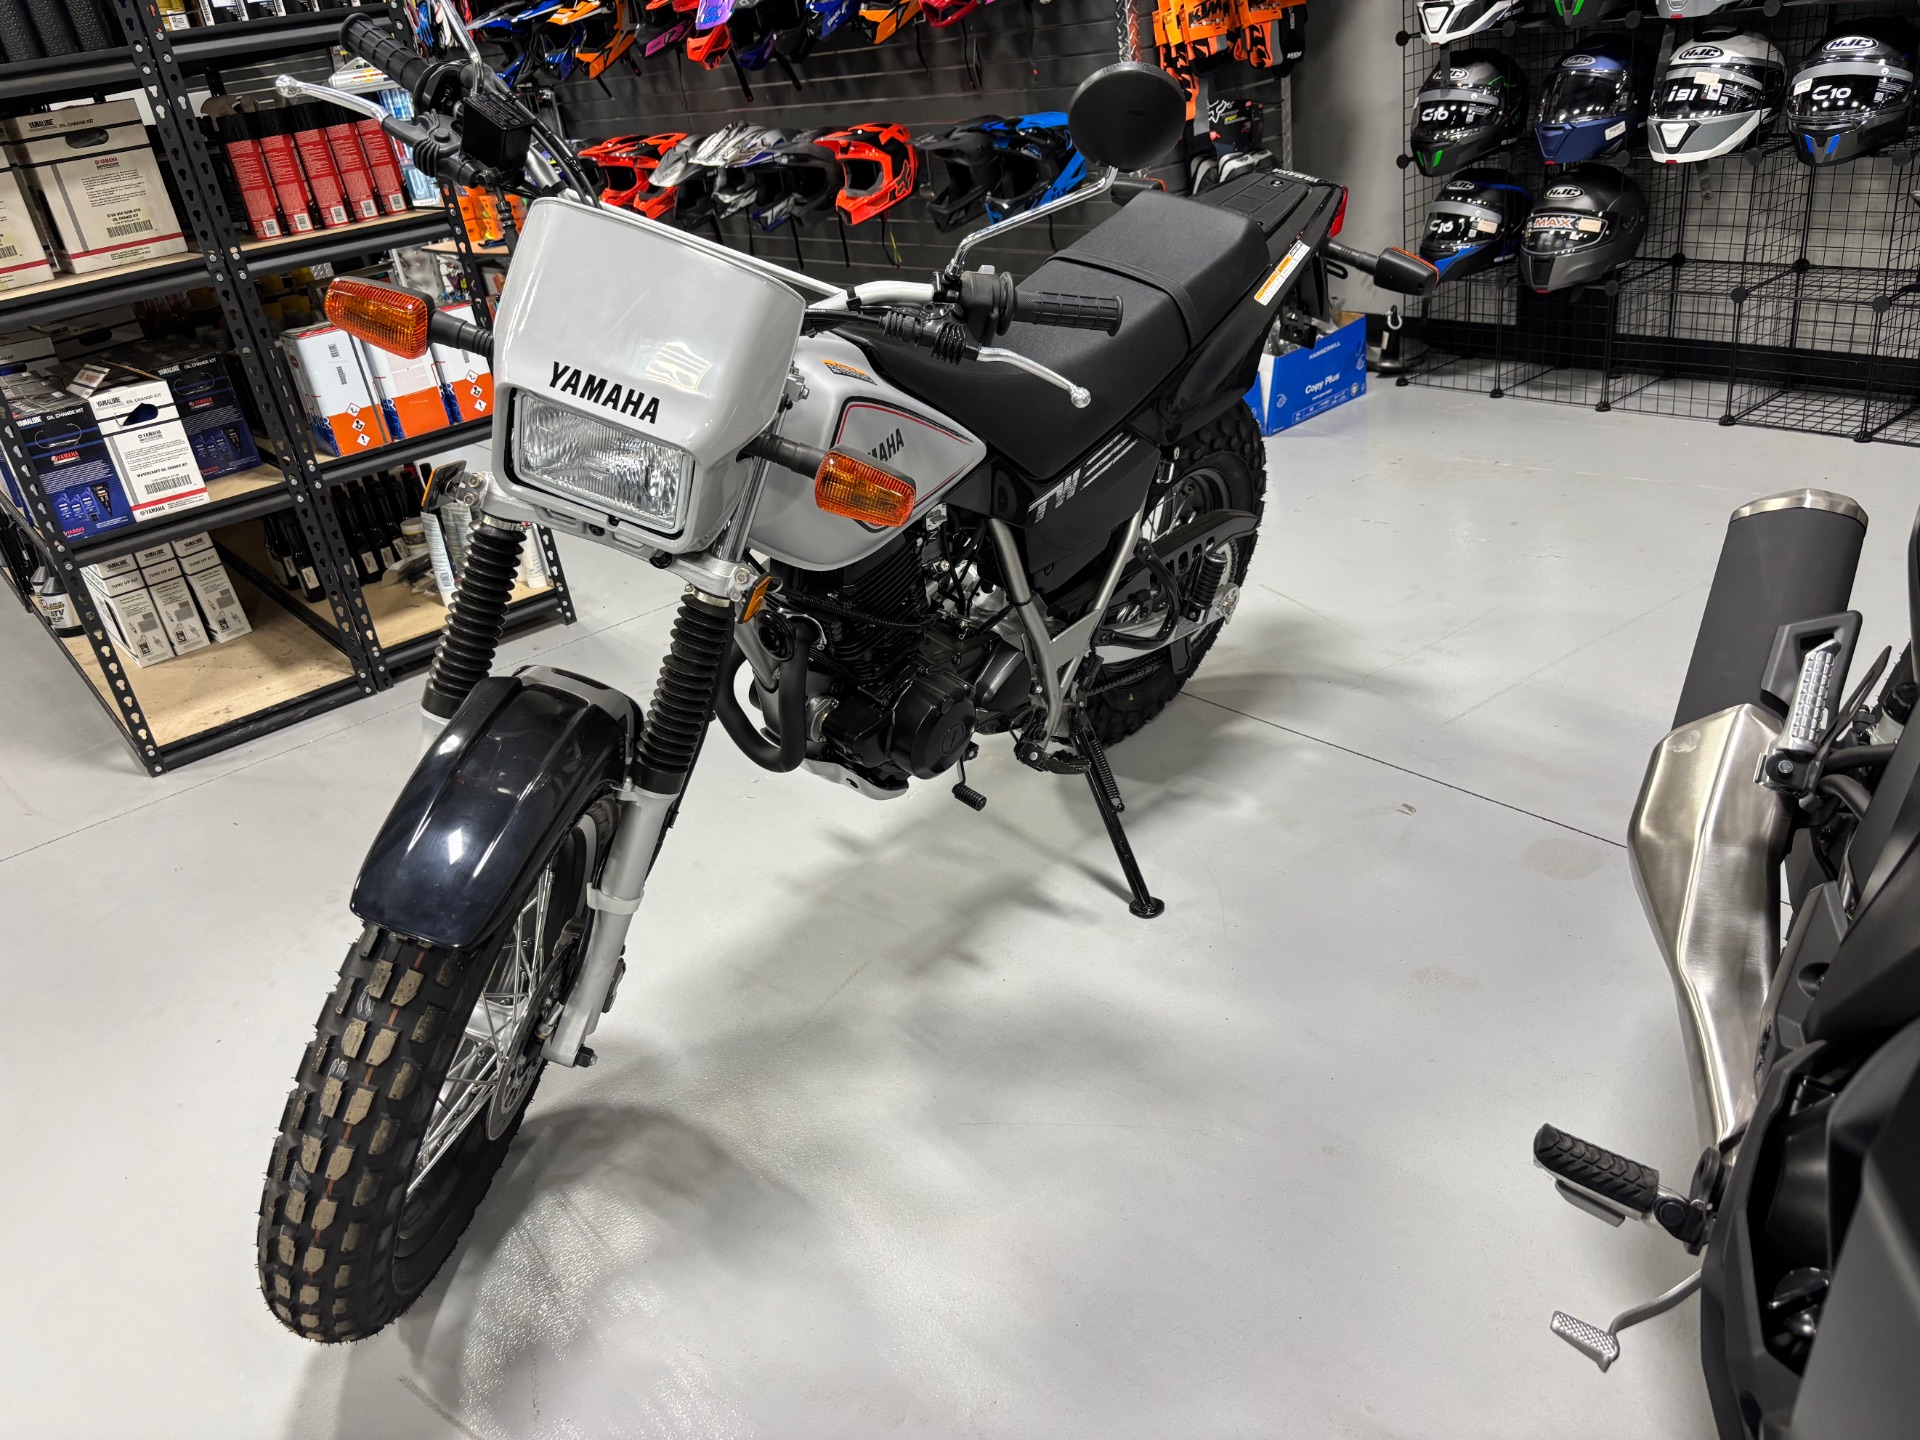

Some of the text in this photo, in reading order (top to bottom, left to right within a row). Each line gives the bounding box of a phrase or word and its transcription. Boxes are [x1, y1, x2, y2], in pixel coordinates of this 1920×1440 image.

[1829, 39, 1870, 49] HJC
[1684, 49, 1718, 57] HJC
[1812, 85, 1852, 100] C10
[28, 119, 54, 129] YAMALUBE
[1533, 216, 1576, 229] MAX
[1309, 341, 1341, 360] HAMMERMILL
[1305, 381, 1324, 395] Copy
[1325, 373, 1340, 386] Plus
[549, 361, 660, 424] YAMAHA
[96, 397, 121, 407] YAMALUBE
[16, 416, 42, 427] YAMALUBE
[55, 410, 75, 418] CHANGE
[57, 451, 79, 460] YAMAHA
[145, 505, 166, 515] YAMAHA
[144, 548, 165, 558] YAMALUBE
[107, 559, 128, 570] YAMALUBE
